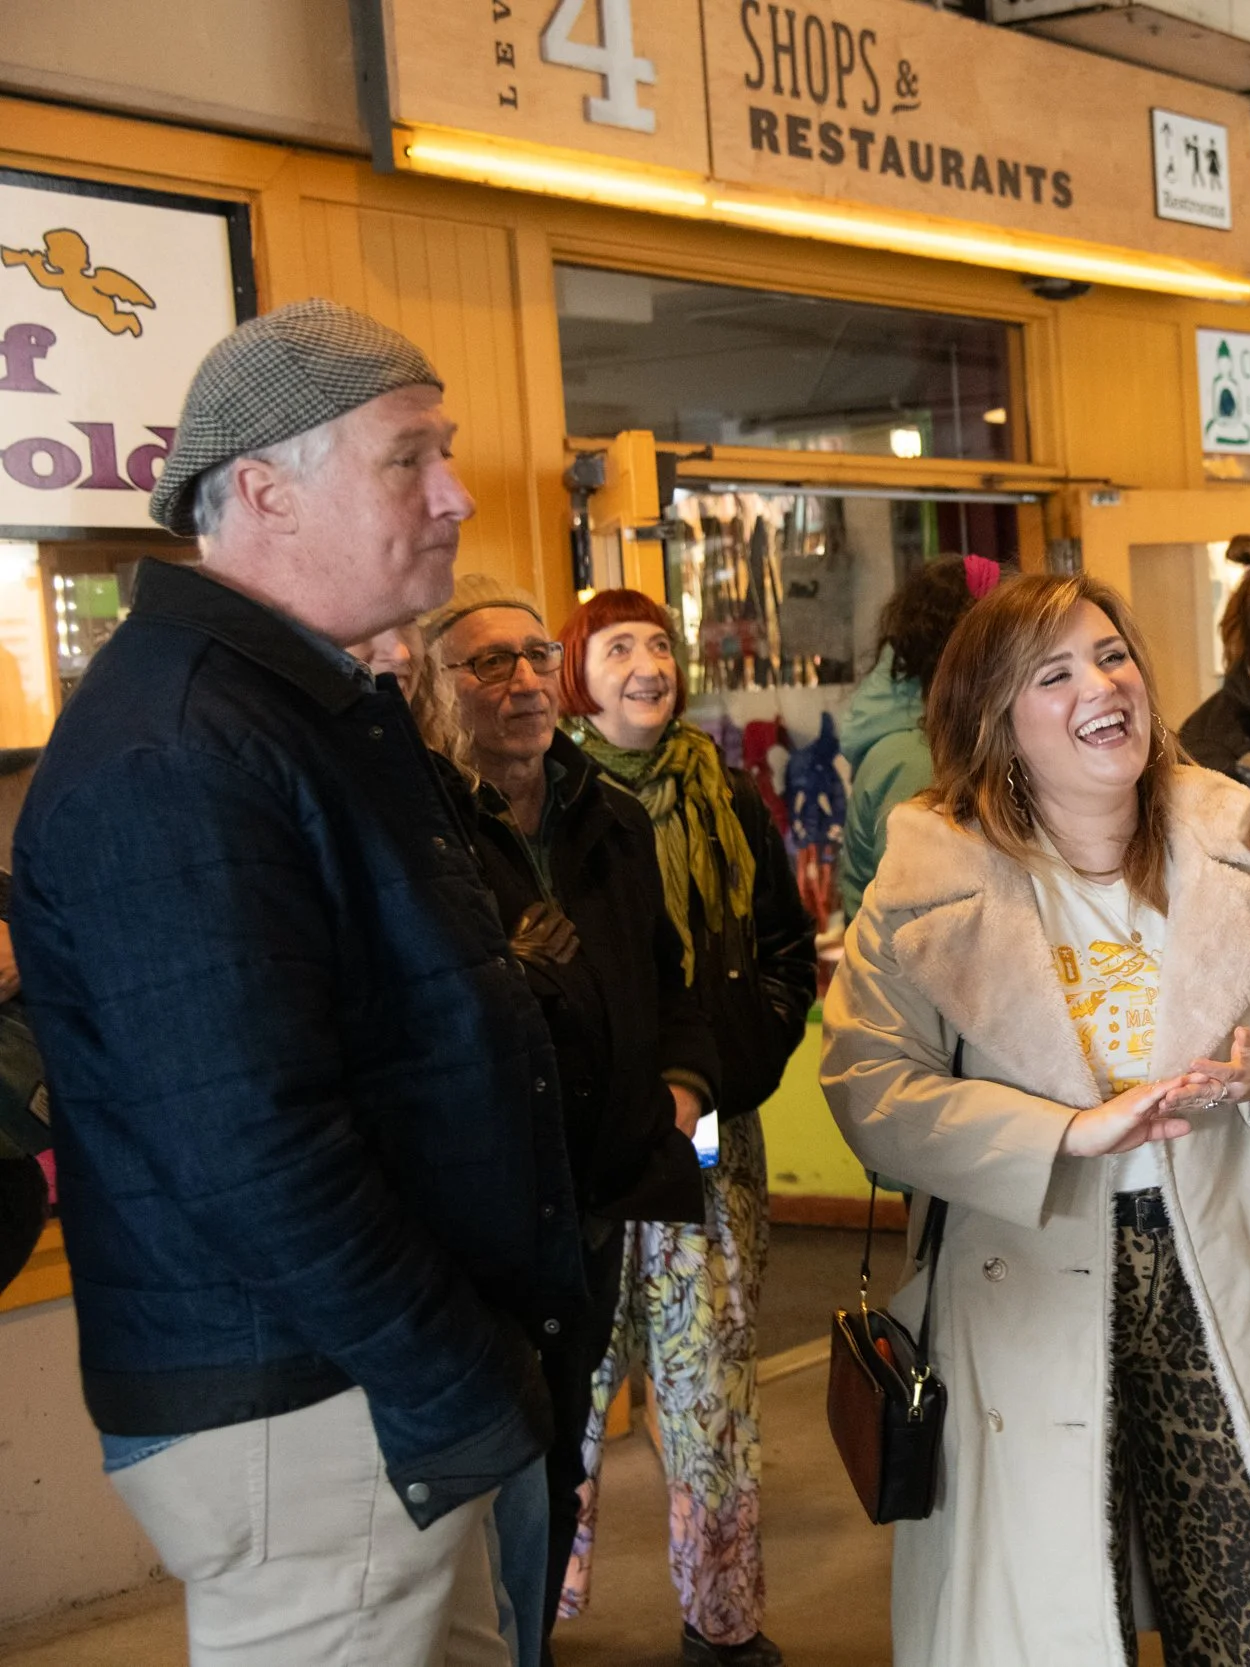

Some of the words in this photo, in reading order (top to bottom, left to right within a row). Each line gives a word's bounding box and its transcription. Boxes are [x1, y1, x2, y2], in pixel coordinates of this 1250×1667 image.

[539, 0, 656, 133] 4
[742, 0, 881, 116] SHOPS
[893, 59, 920, 108] &
[749, 106, 1073, 208] RESTAURANTS
[0, 422, 176, 492] old
